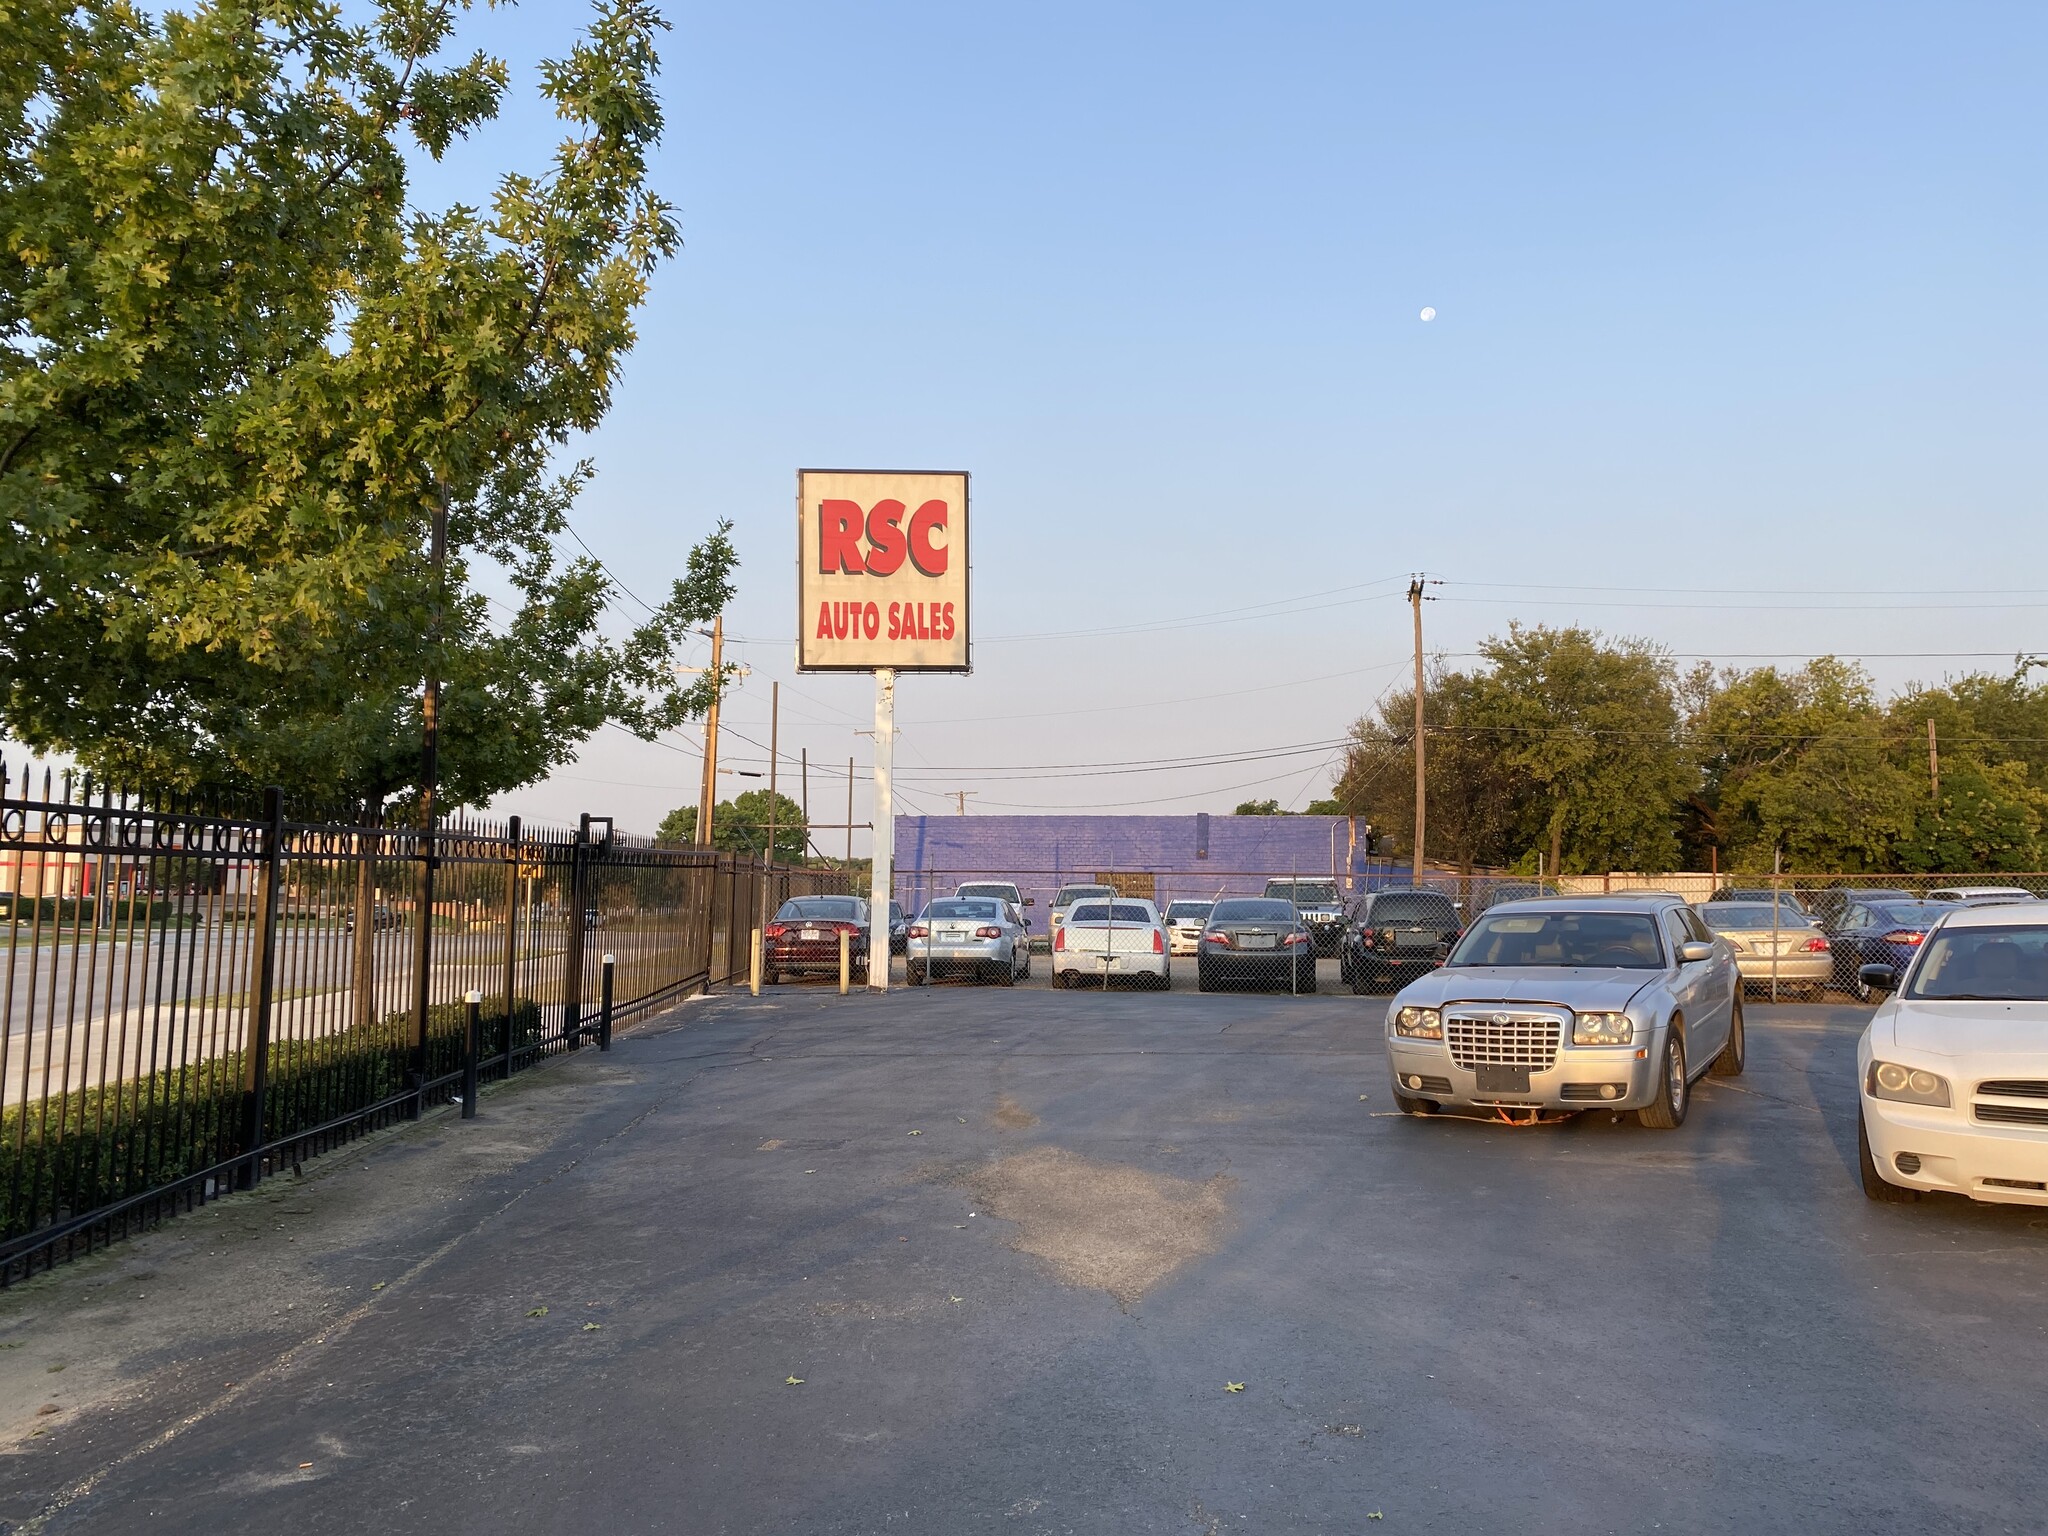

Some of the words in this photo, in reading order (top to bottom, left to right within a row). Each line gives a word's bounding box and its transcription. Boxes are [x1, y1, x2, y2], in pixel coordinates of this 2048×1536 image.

[818, 499, 949, 577] RSC
[816, 601, 880, 640] AUTO
[887, 601, 955, 641] SALES
